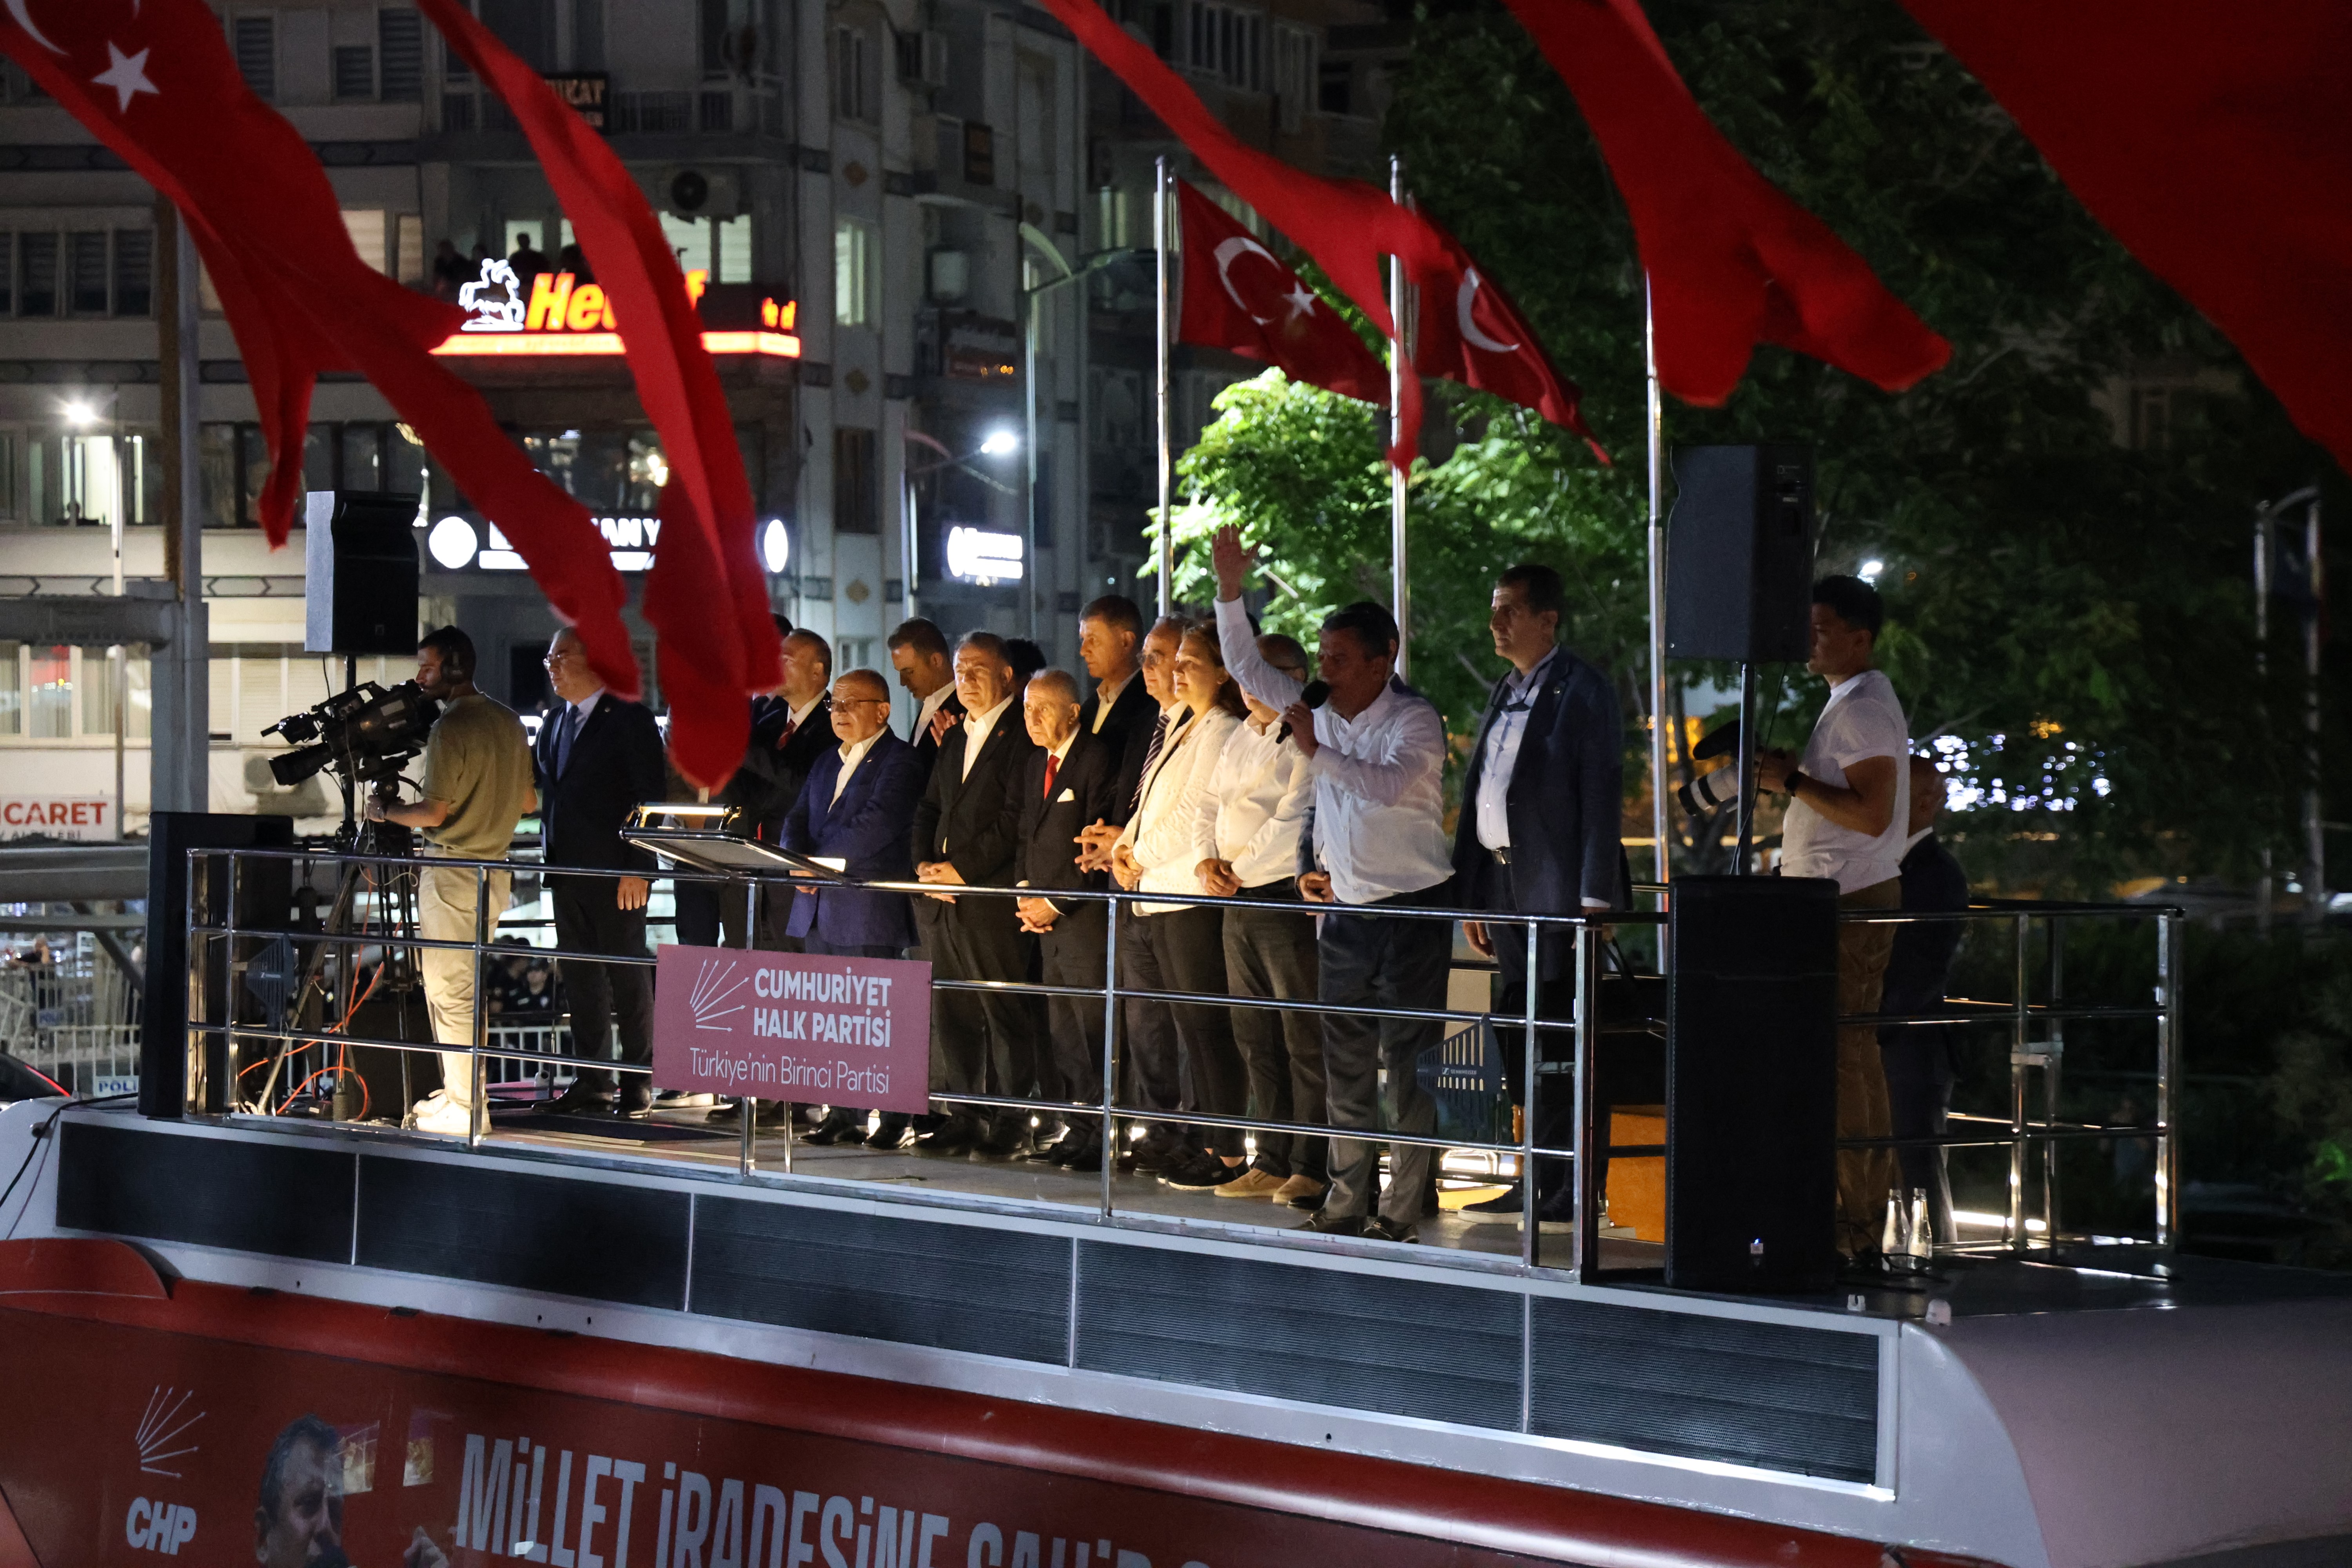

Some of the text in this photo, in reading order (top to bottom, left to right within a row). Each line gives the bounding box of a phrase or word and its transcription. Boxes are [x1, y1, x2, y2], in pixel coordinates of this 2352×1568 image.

[524, 269, 709, 331] Hef
[0, 802, 107, 825] CARET
[755, 966, 892, 1007] CUMHURİYET
[753, 1007, 891, 1047] HALK PARTİSİ
[690, 1047, 889, 1094] Türkiye'nin Birinci Partisi
[126, 1496, 197, 1555] CHP
